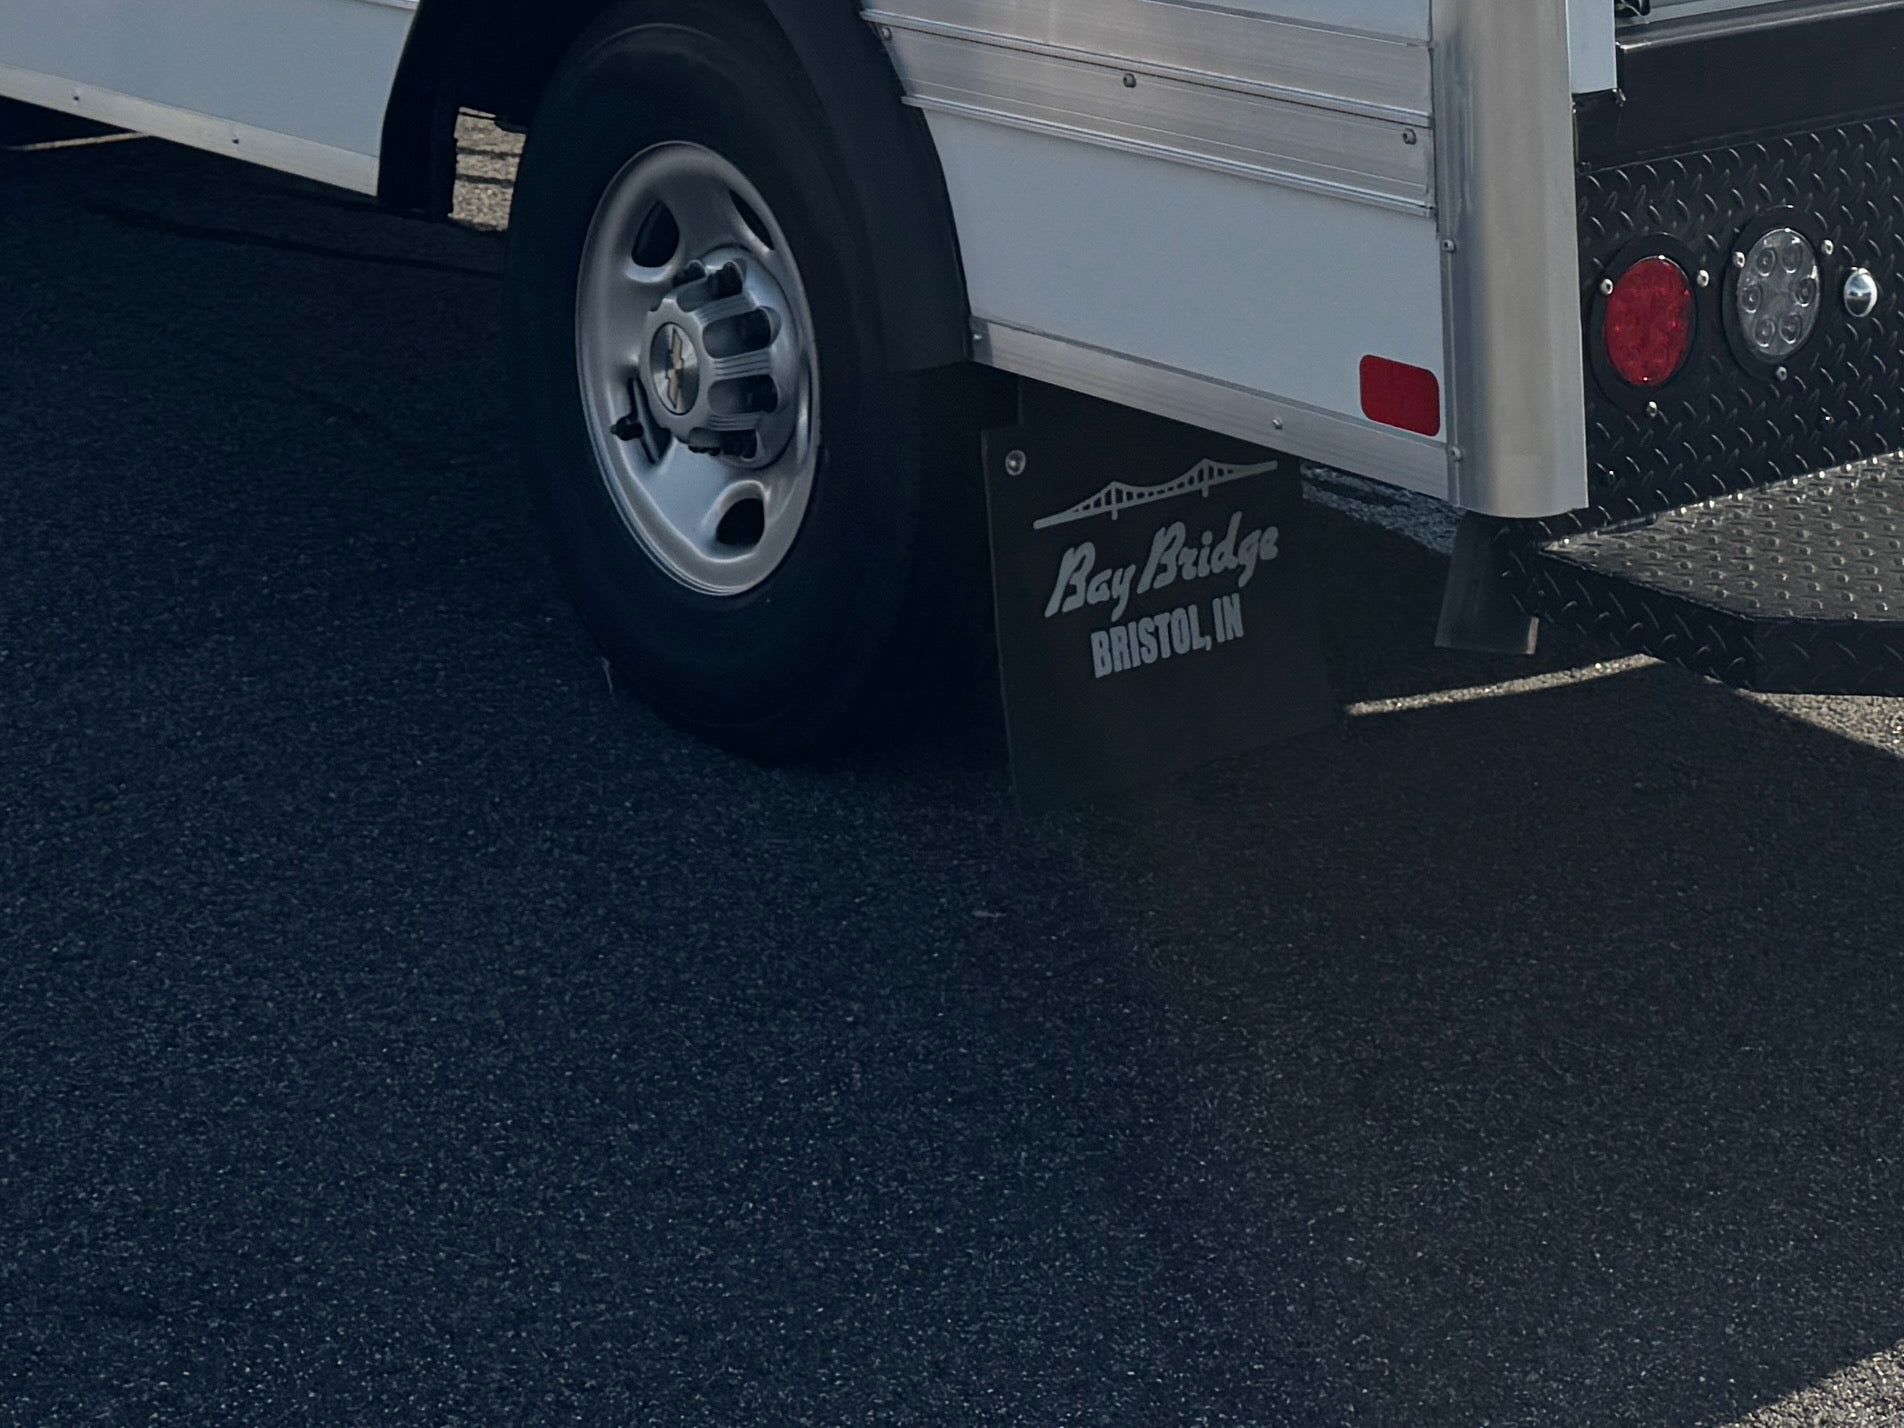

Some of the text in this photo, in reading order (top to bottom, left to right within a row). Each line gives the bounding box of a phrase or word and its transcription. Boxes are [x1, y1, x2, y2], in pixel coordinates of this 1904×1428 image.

[1045, 511, 1279, 622] Bay Bridge
[1090, 593, 1244, 678] BRISTOL, IN
